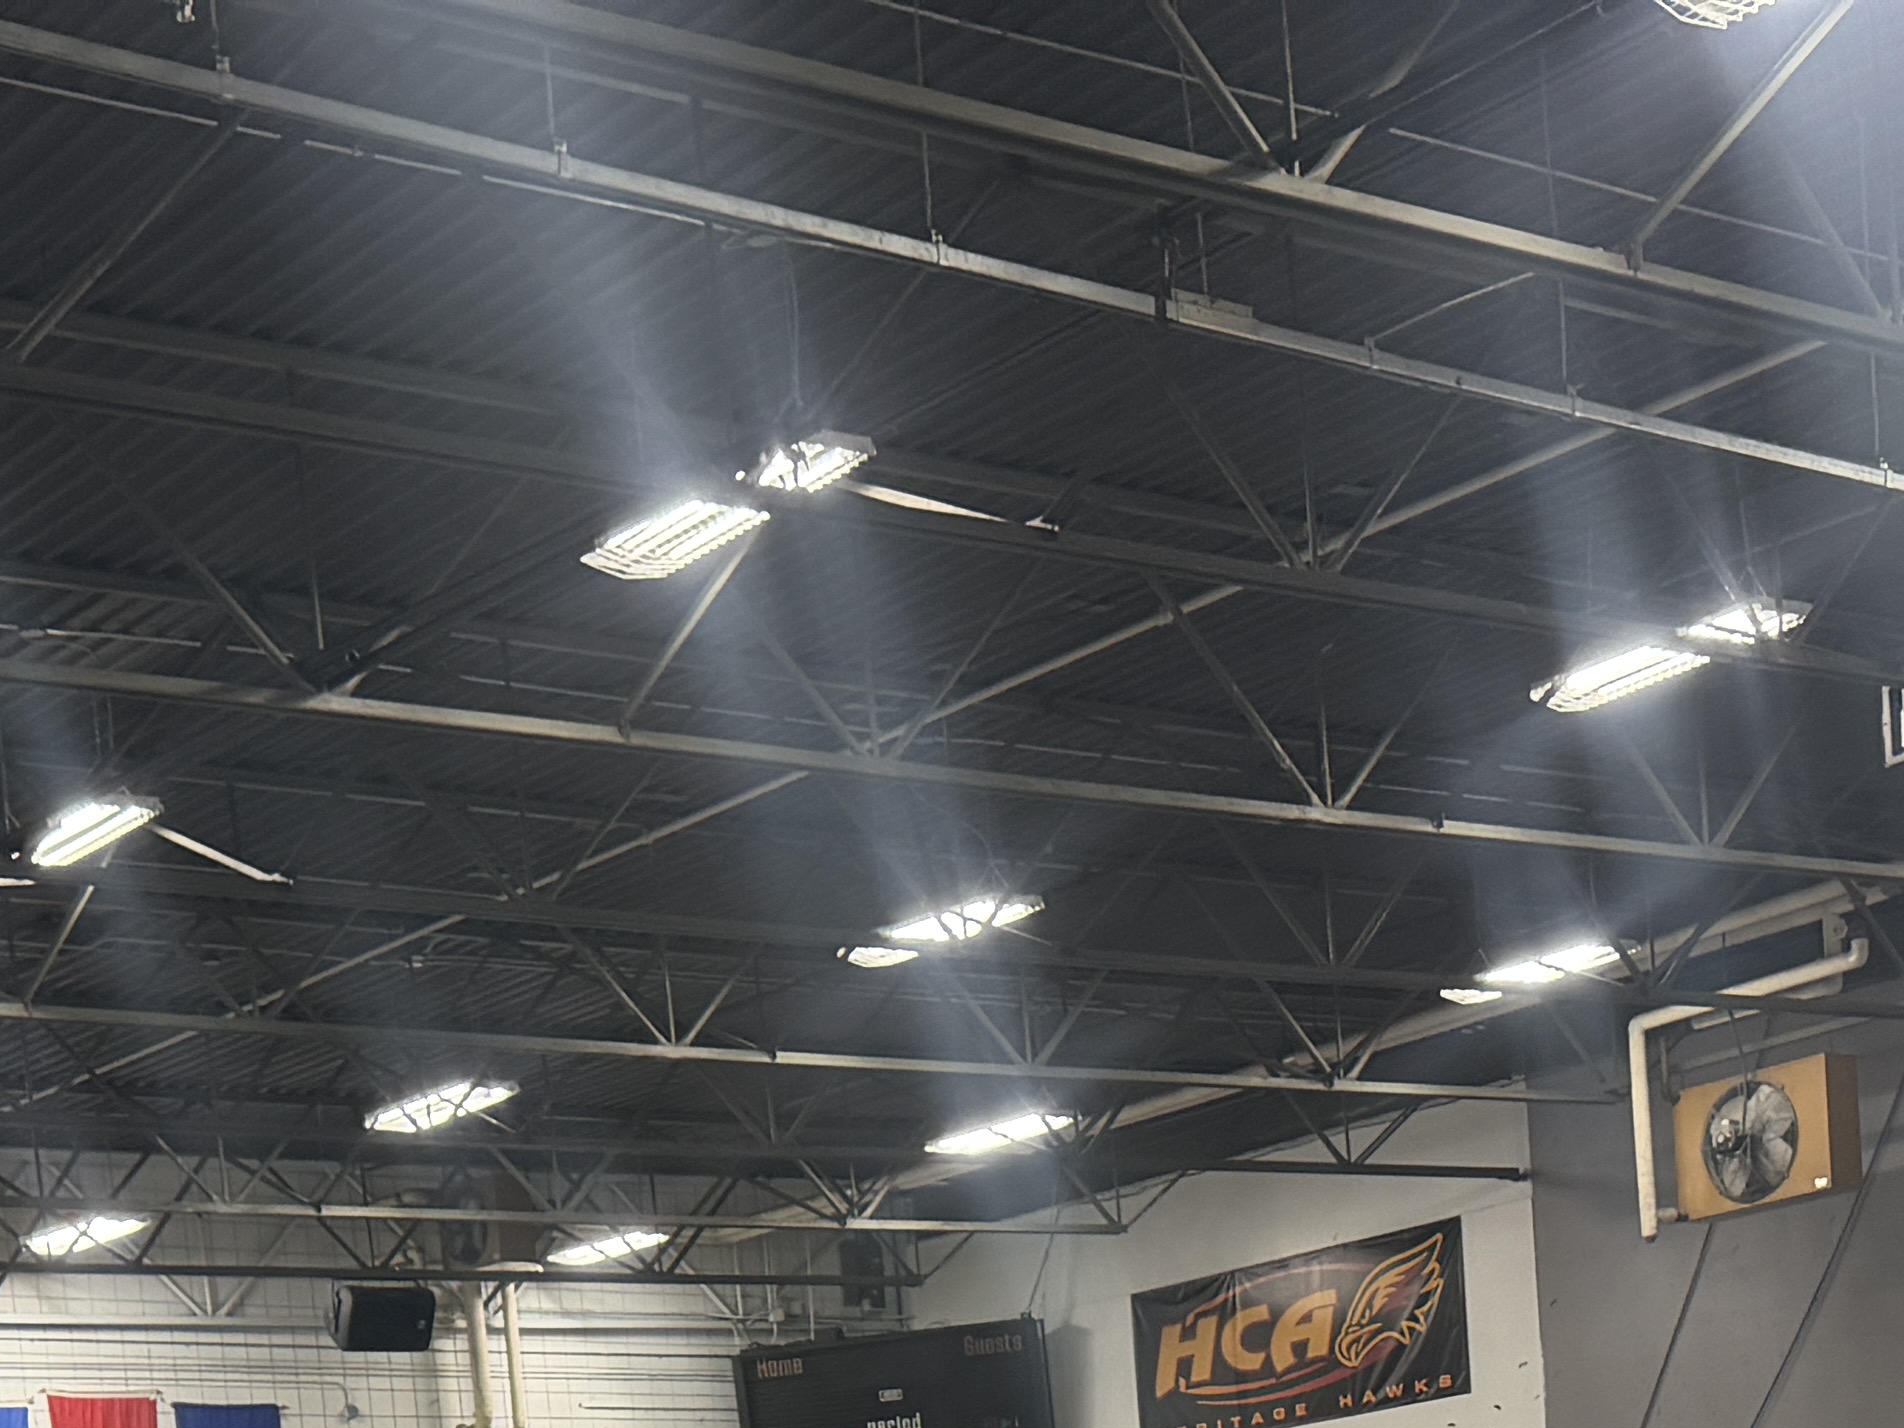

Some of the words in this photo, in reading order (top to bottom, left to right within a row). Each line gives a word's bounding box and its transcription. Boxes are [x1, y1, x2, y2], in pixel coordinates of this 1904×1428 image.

[1155, 1288, 1338, 1400] HCA
[756, 1357, 804, 1379] Home
[1338, 1374, 1453, 1409] HAWKS
